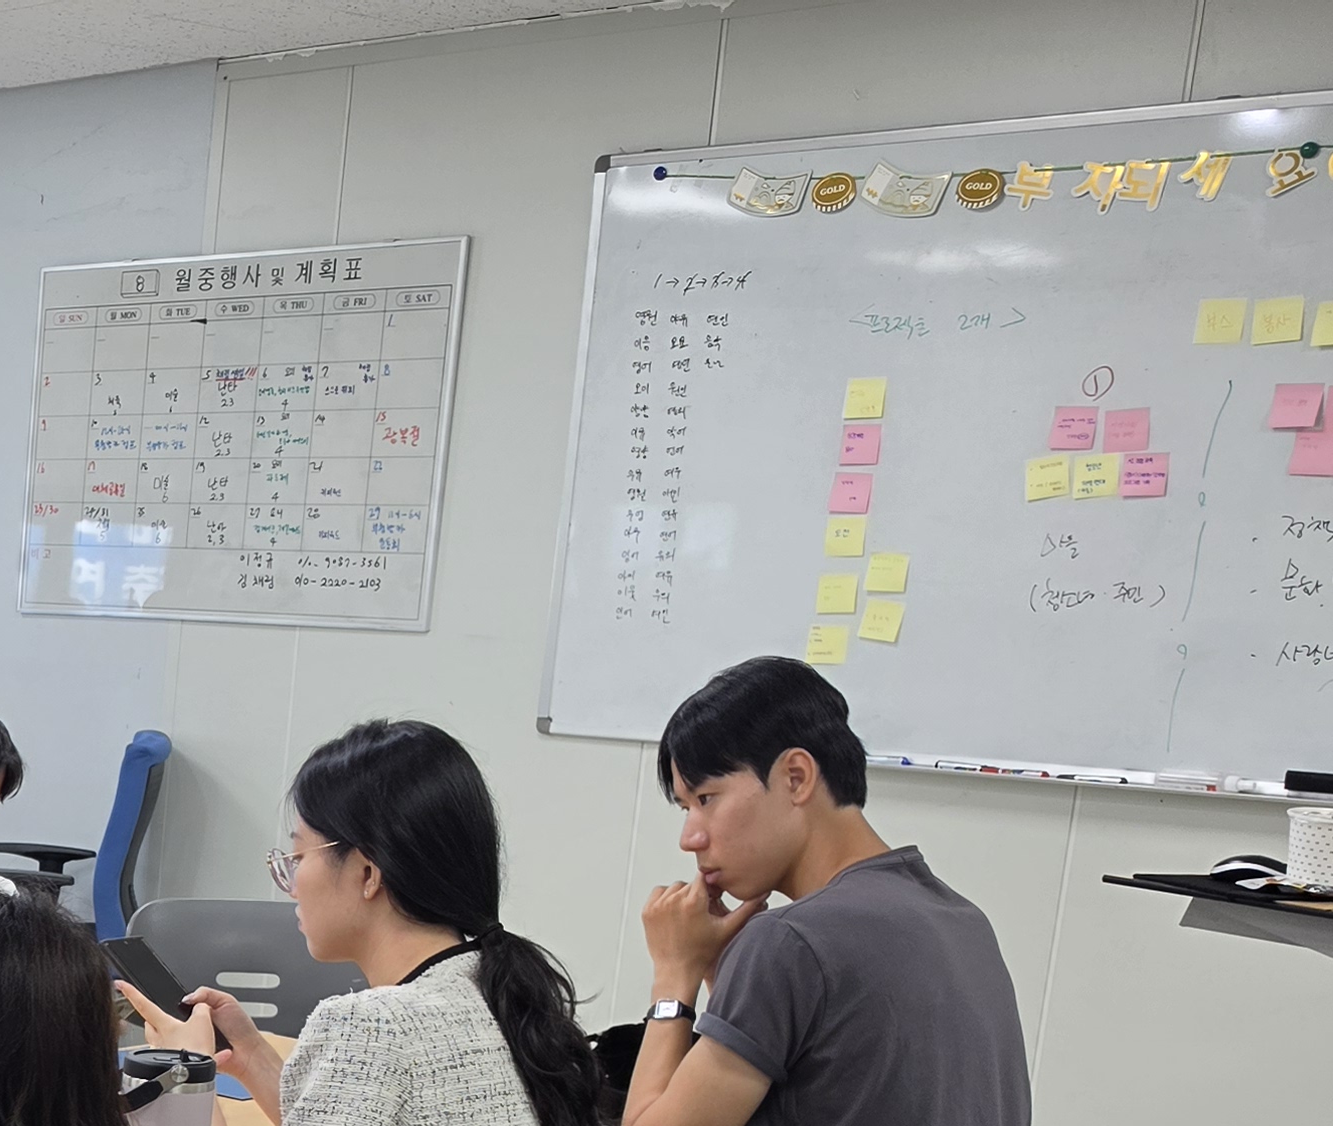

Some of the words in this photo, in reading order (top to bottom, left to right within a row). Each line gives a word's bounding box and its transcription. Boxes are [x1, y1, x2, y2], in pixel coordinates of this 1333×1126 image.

[819, 184, 847, 198] GOLD
[965, 180, 993, 193] GOLD
[135, 275, 145, 292] 8
[175, 263, 262, 292] 월중행사
[270, 267, 284, 286] 및
[294, 257, 363, 286] 계획표
[353, 297, 368, 307] FRI
[415, 293, 433, 303] SAT
[220, 304, 228, 314] 수
[231, 303, 250, 313] WED
[290, 300, 308, 310] THU
[110, 311, 117, 320] 월
[120, 310, 137, 320] MON
[165, 308, 173, 317] 화
[176, 307, 191, 317] TUE
[68, 313, 83, 323] SUN
[1207, 313, 1233, 332] 부스
[1263, 313, 1291, 333] 봉사
[634, 335, 651, 351] 이응
[202, 370, 212, 381] 5
[321, 365, 329, 378] 7
[383, 364, 390, 376] 8
[44, 376, 51, 387] 2
[94, 373, 102, 386] 3
[148, 372, 157, 384] 4
[634, 383, 650, 394] 오이
[199, 415, 210, 425] 12
[256, 415, 265, 424] 13
[314, 414, 325, 424] 14
[375, 411, 387, 422] 15
[41, 419, 47, 431] 9
[383, 426, 420, 447] 광복절
[275, 445, 284, 457] 4
[37, 462, 46, 474] 16
[195, 461, 206, 473] 19
[373, 460, 383, 471] 22
[271, 492, 279, 501] 4
[33, 505, 59, 516] 23/30
[191, 508, 201, 516] 26
[249, 508, 260, 517] 27
[369, 507, 381, 518] 29
[155, 534, 161, 544] 6
